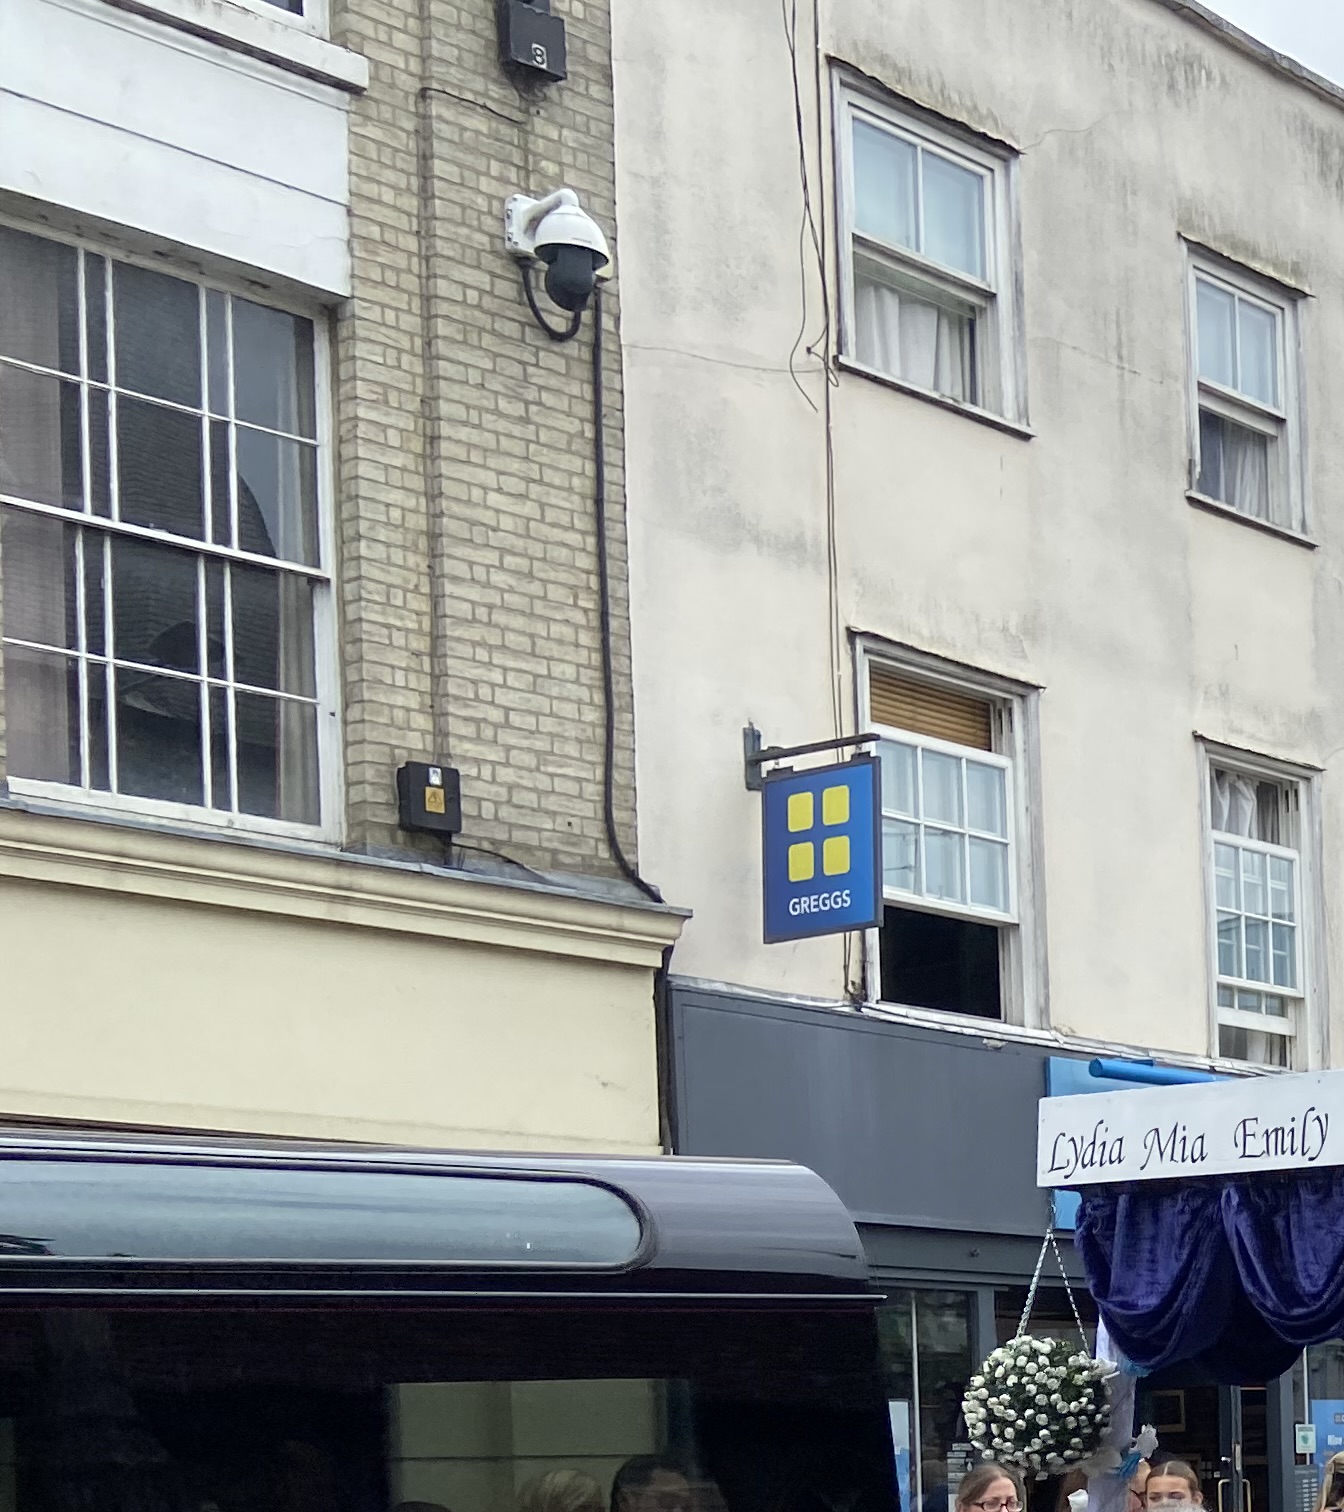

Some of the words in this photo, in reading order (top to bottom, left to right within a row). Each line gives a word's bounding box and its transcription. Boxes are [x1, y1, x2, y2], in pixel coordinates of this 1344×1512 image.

[788, 889, 851, 916] GREGGS
[1047, 1118, 1126, 1180] Lydia
[1139, 1121, 1208, 1171] Mia
[1233, 1105, 1330, 1162] Emily
